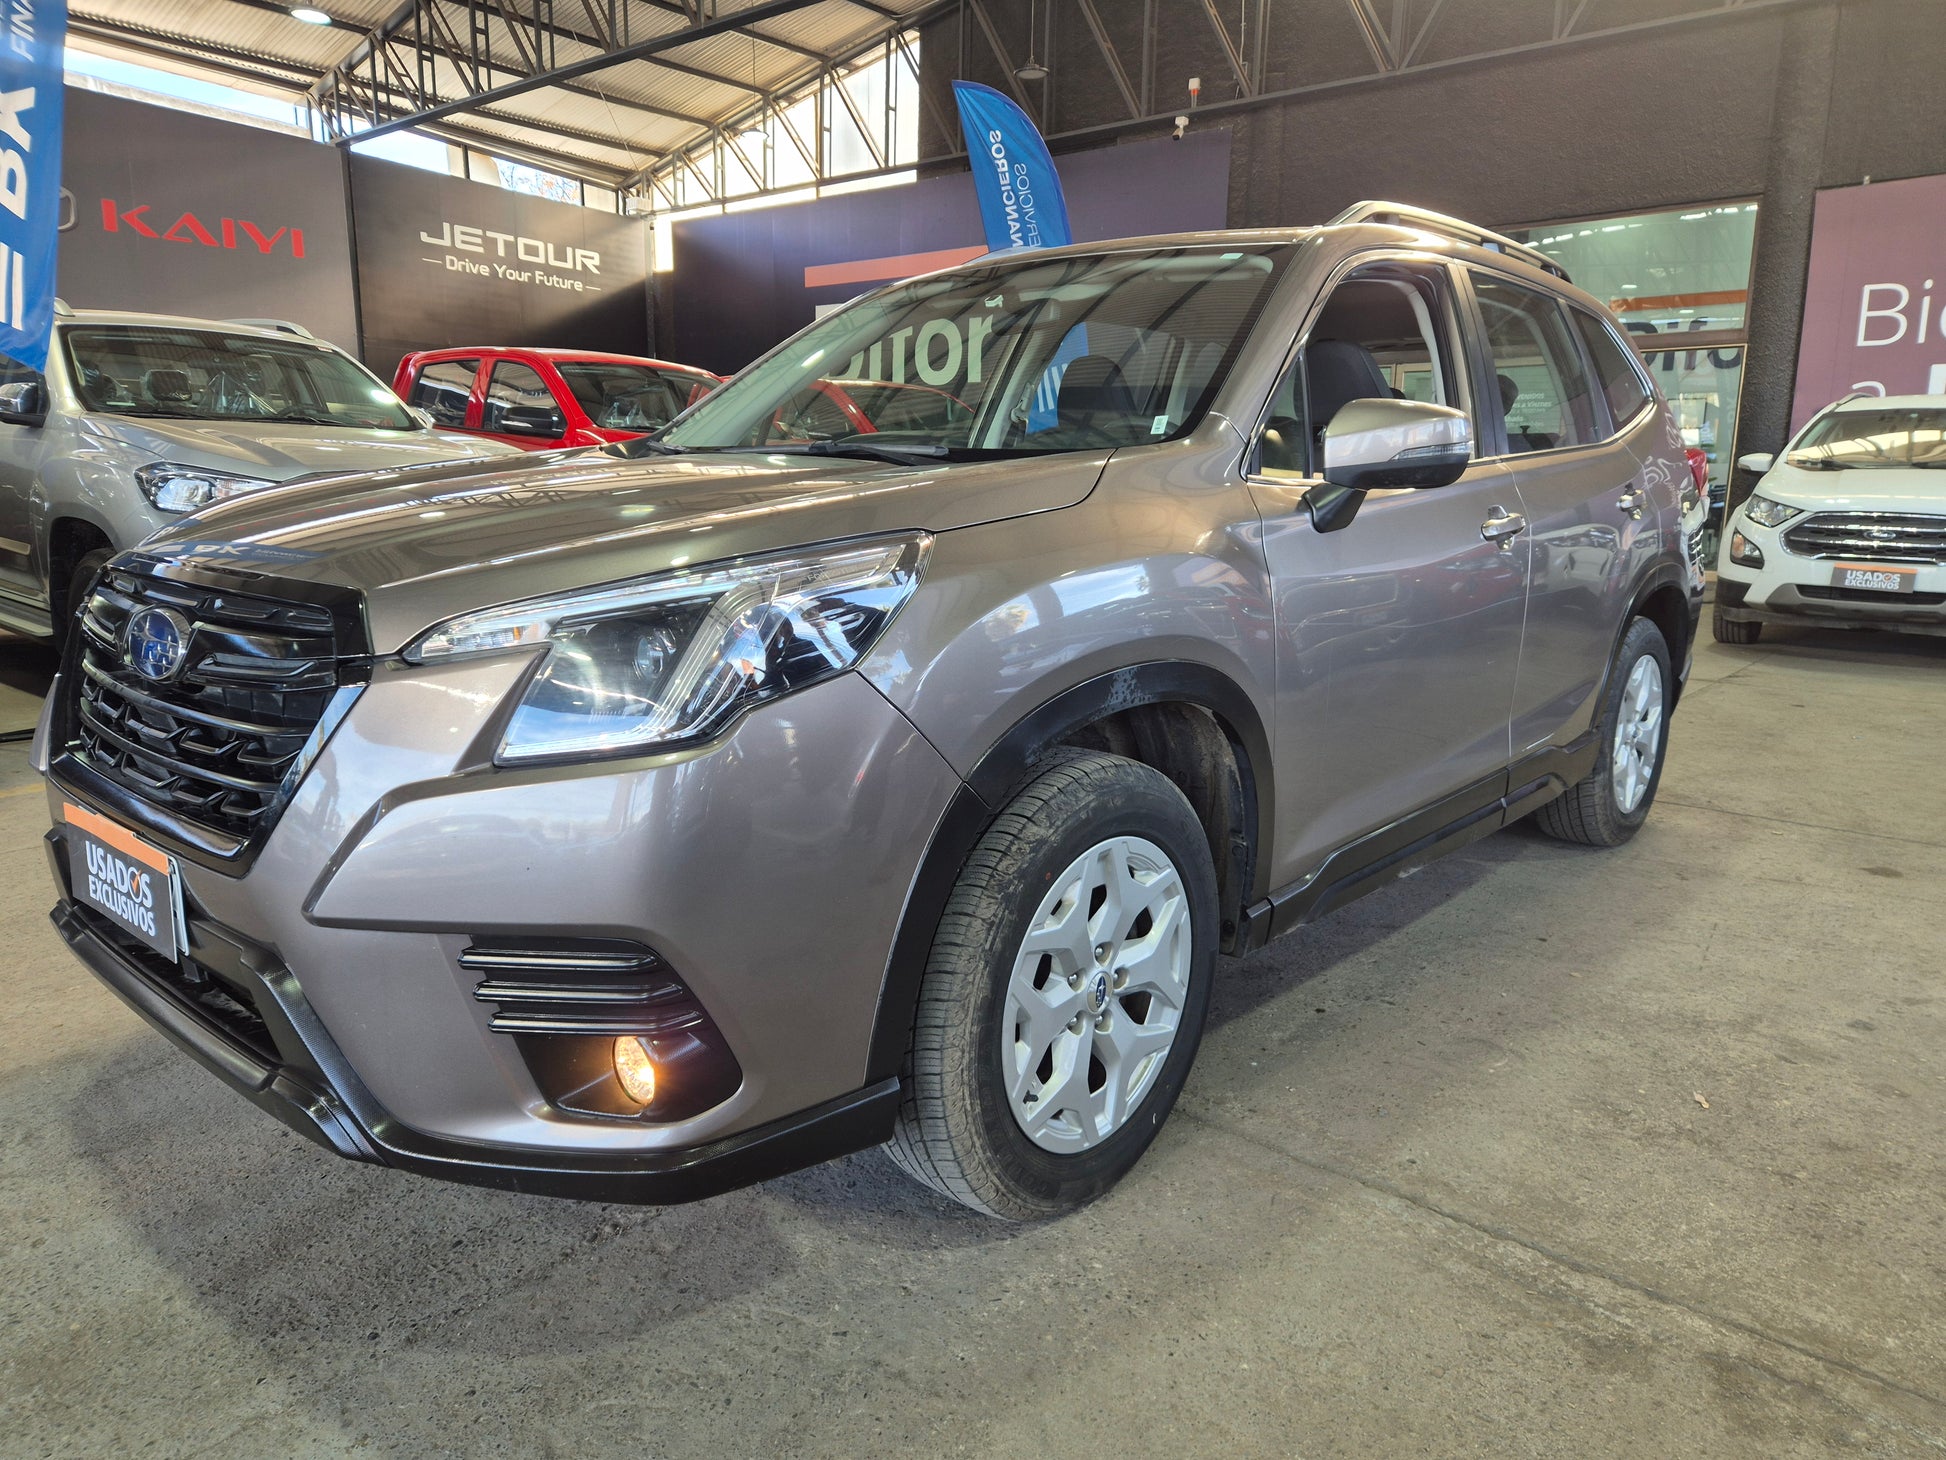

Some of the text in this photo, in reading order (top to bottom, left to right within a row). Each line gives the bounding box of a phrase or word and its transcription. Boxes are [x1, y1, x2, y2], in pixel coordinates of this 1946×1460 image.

[101, 198, 305, 259] KAIYI
[419, 222, 601, 275] JETOUR
[445, 254, 583, 292] Drive Your Future
[1856, 279, 1946, 347] Bi
[1844, 578, 1900, 590] EXCLUSIVOS
[1847, 570, 1901, 583] USADOS
[85, 840, 153, 908] USADOS
[88, 874, 156, 937] EXCLUSIVOS
